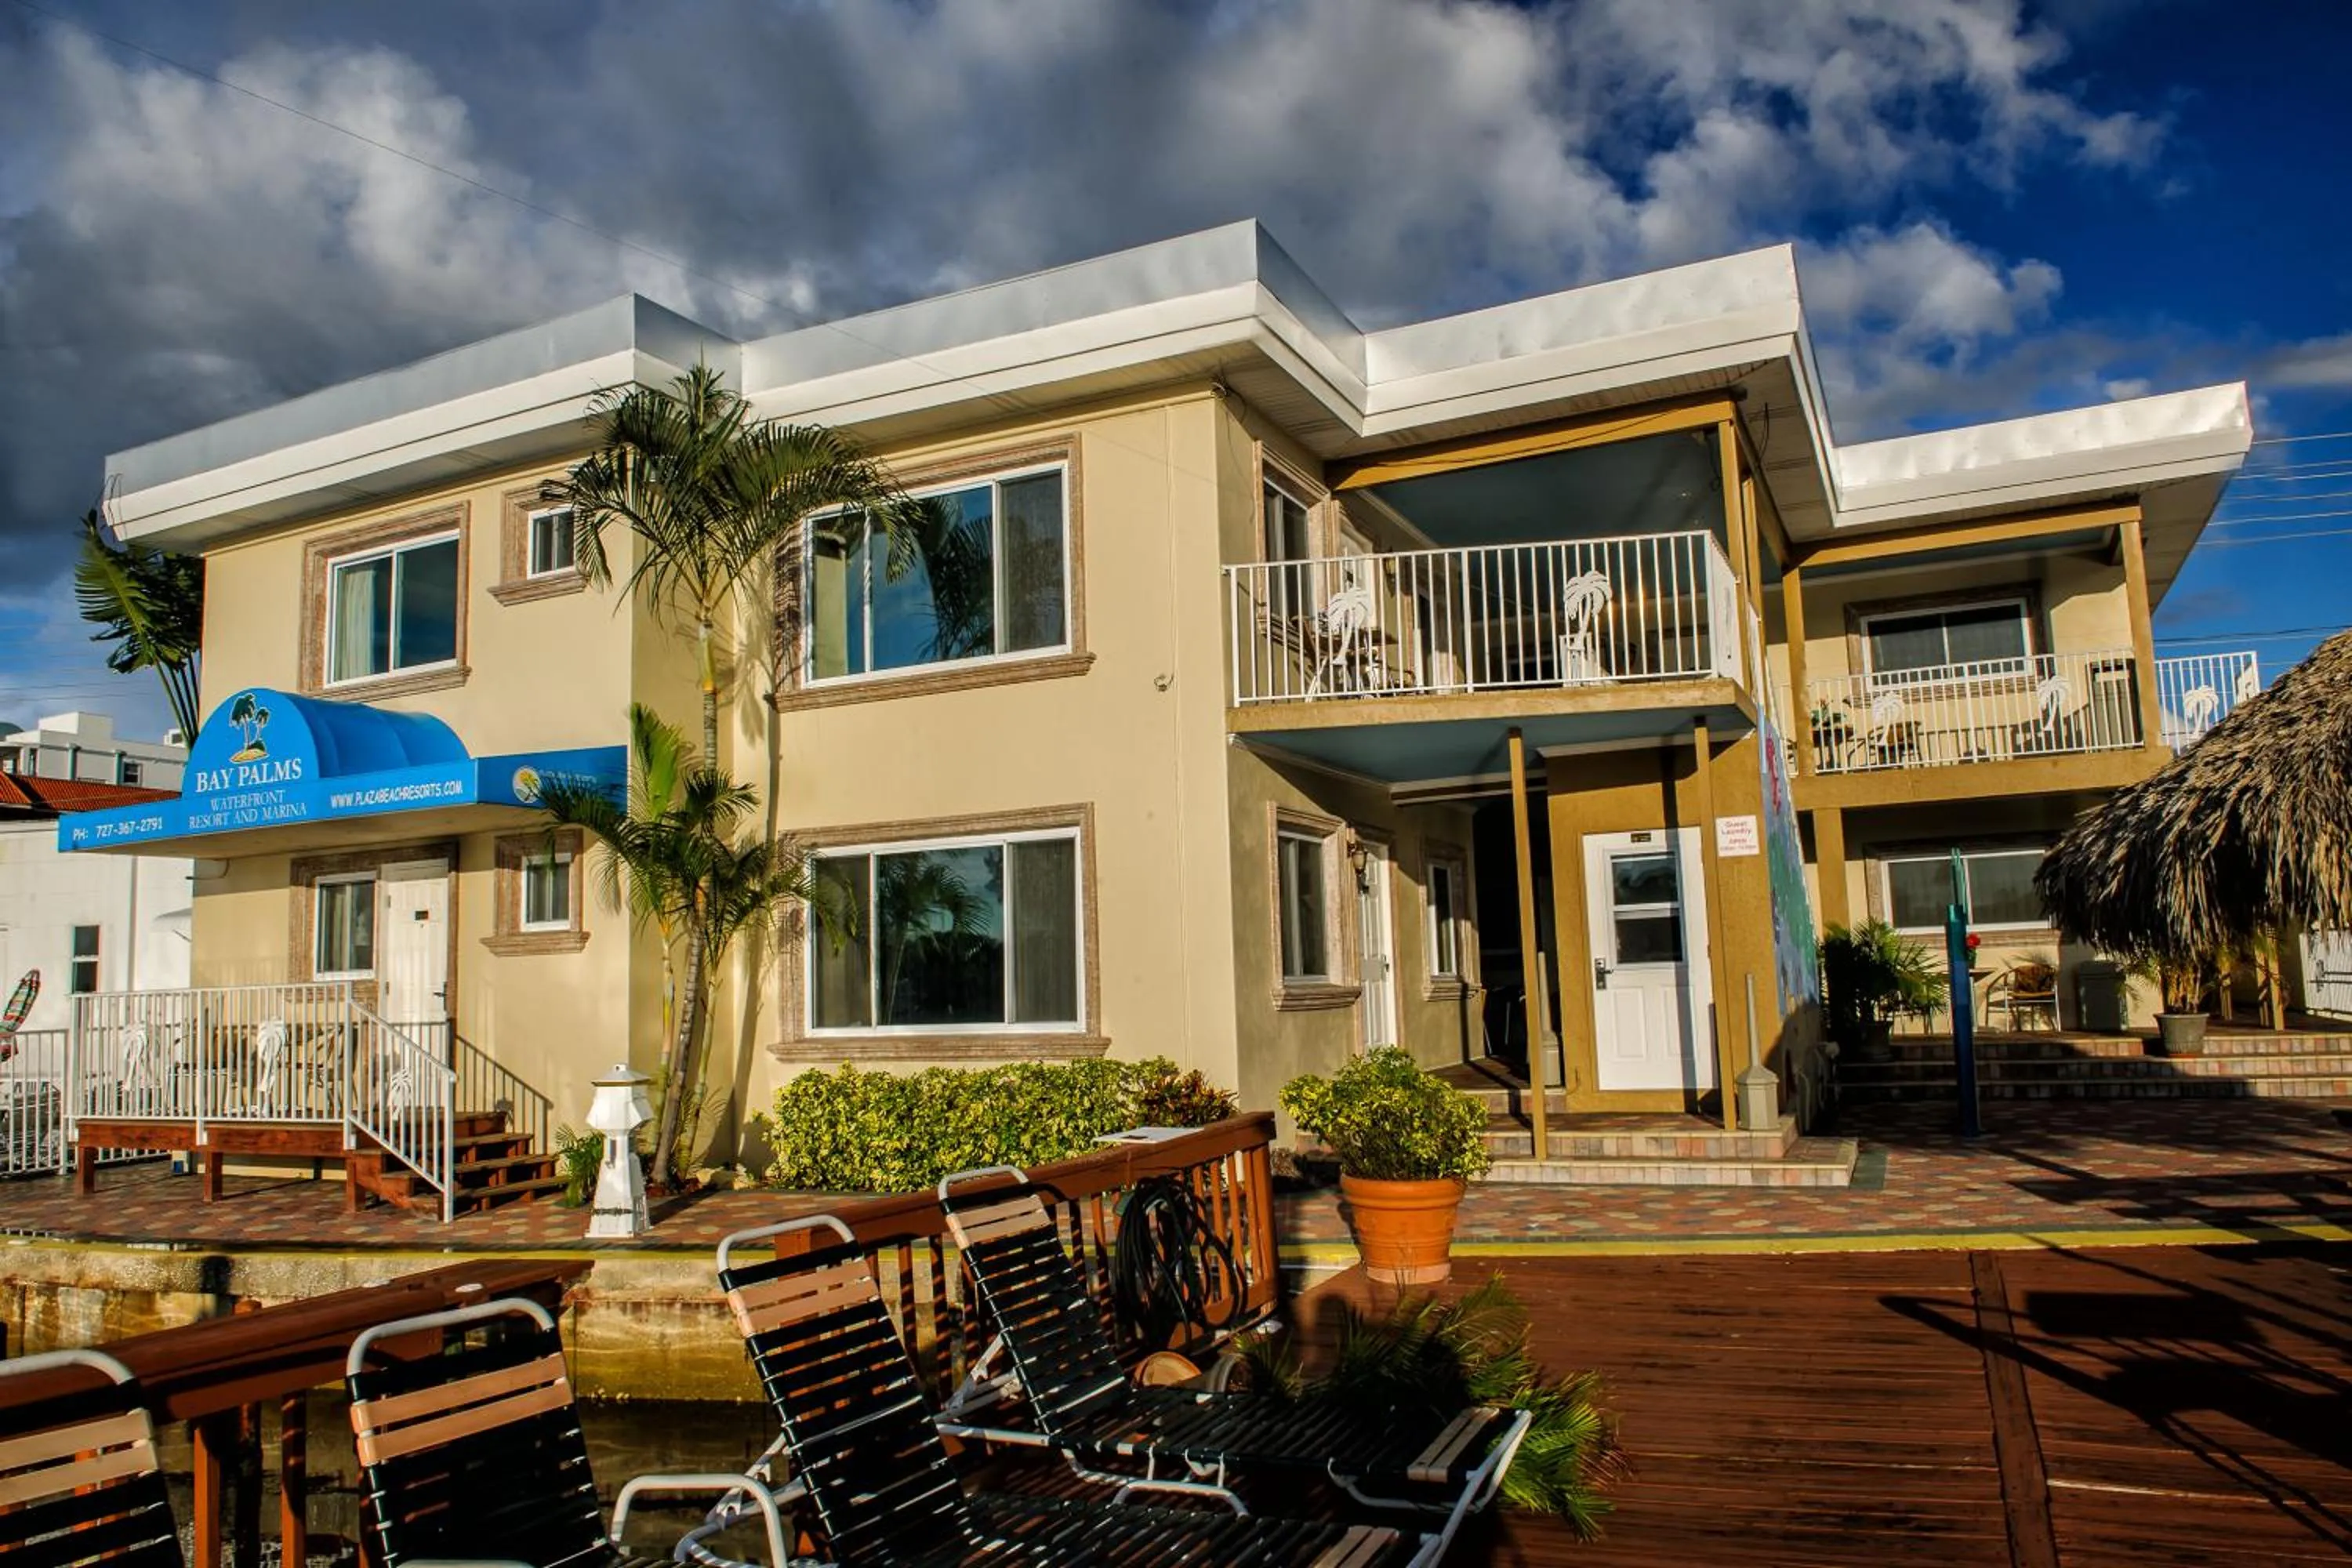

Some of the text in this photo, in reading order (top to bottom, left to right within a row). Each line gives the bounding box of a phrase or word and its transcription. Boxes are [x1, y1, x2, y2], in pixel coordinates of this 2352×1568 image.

[195, 757, 303, 793] BAY PALMS
[210, 789, 285, 811] WATERFRONT
[330, 780, 463, 809] WWW.PLAZABEACHRESORTS.COM
[73, 816, 163, 841] PH: 727-367-2791
[188, 802, 307, 829] RESORT AND MARINA
